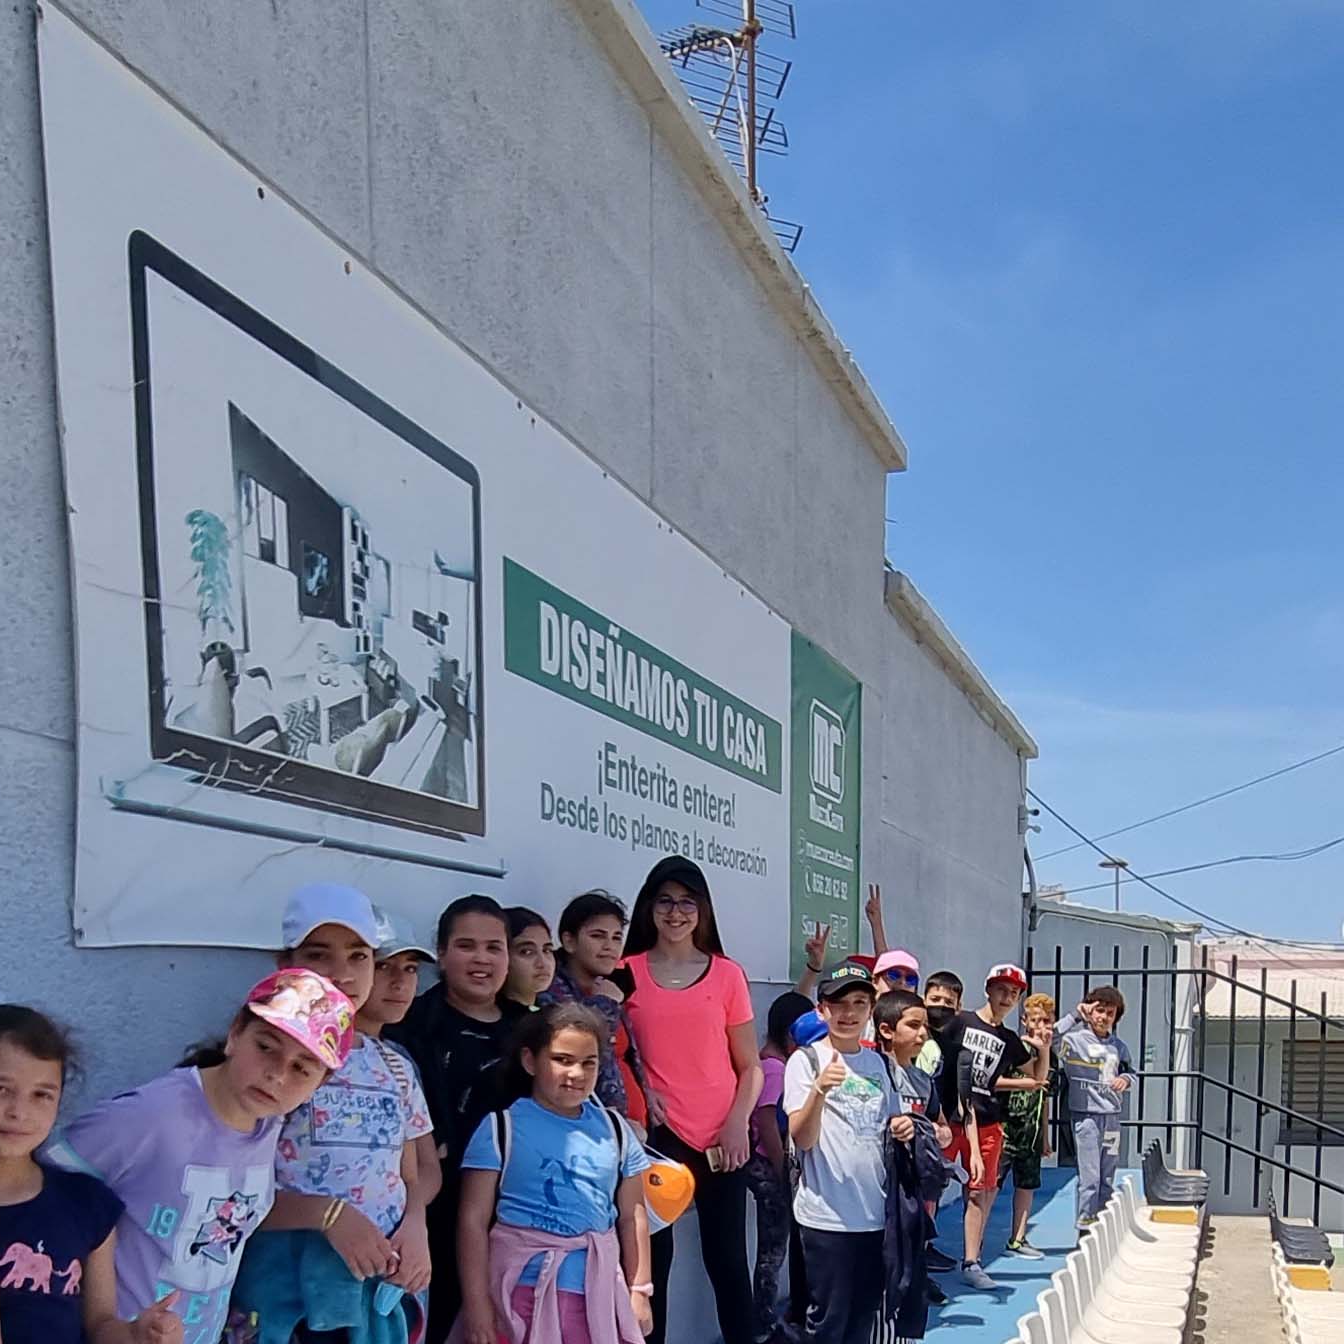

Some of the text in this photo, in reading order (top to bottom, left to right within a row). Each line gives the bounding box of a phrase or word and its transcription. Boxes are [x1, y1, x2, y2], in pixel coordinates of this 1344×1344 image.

[540, 601, 767, 775] DISEÑAMOS TU CASA
[541, 782, 599, 833] Desde
[604, 802, 627, 841] los
[632, 815, 679, 854] planos
[682, 835, 690, 857] a
[694, 831, 704, 861] la
[708, 836, 767, 877] decoración
[598, 742, 736, 828] ¡Enterita entera!
[973, 1051, 995, 1069] EW
